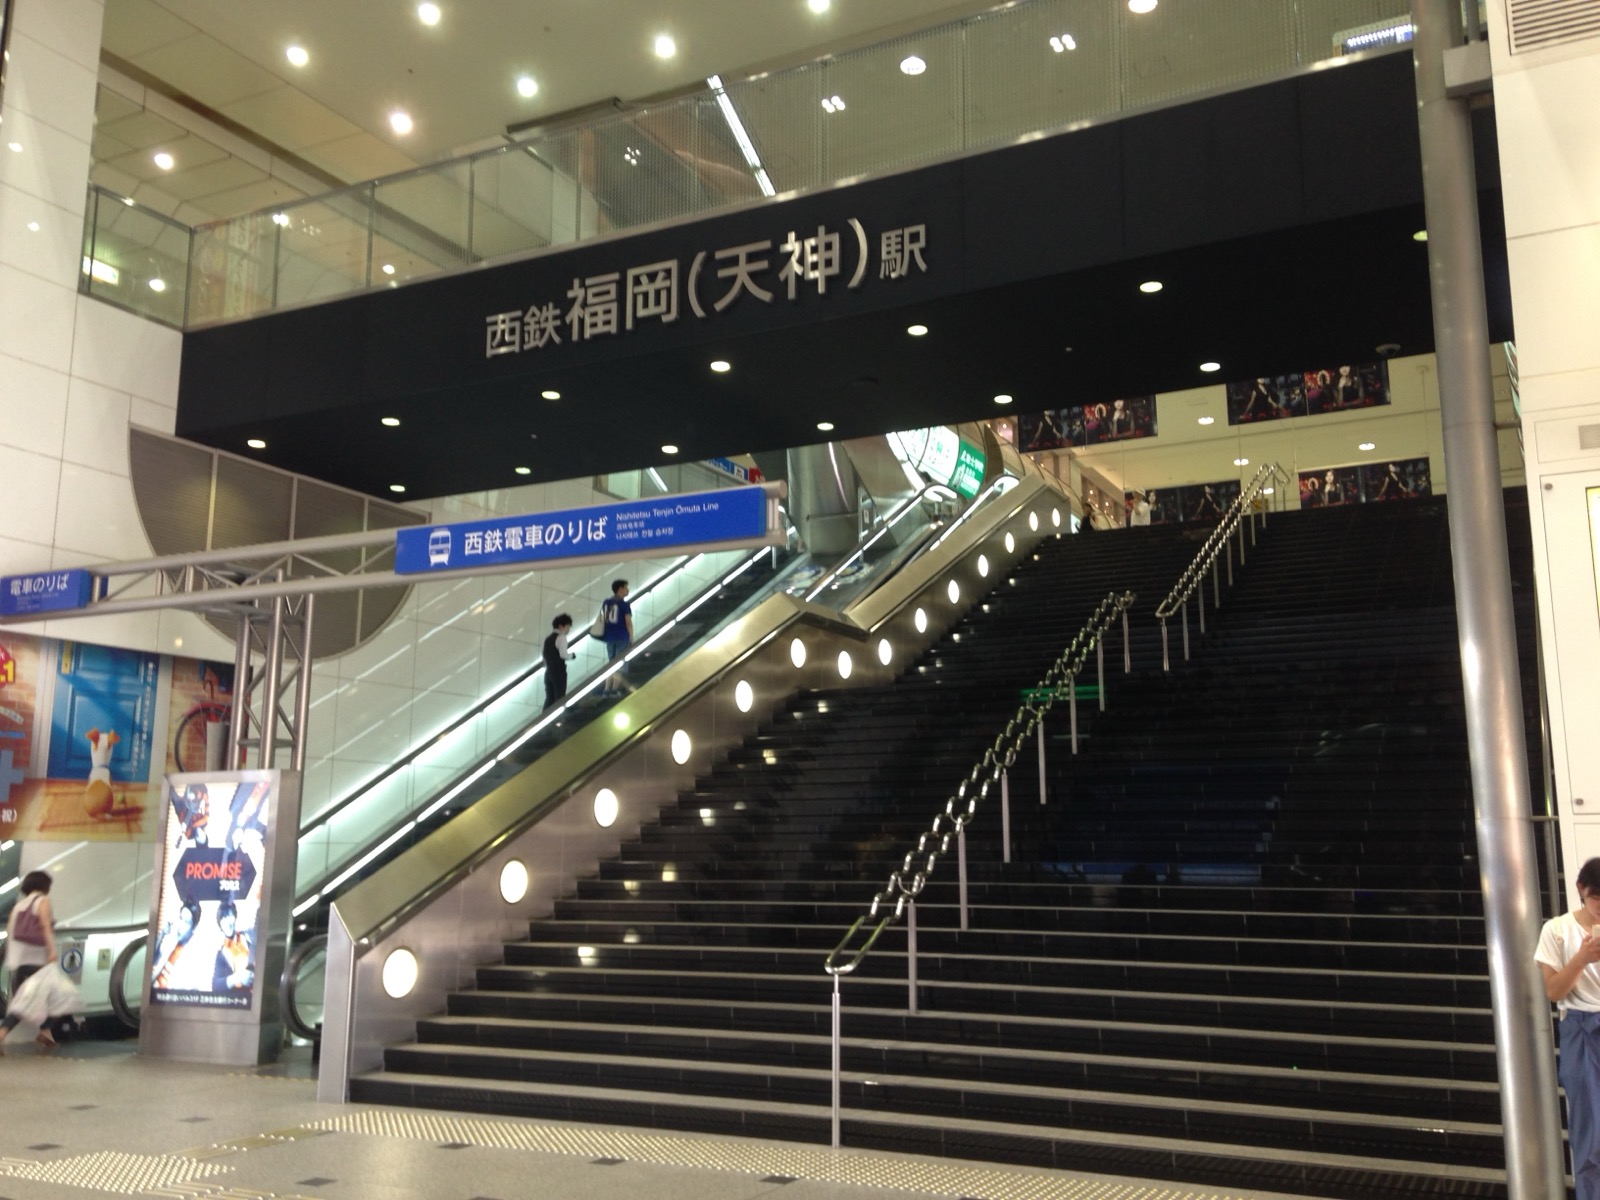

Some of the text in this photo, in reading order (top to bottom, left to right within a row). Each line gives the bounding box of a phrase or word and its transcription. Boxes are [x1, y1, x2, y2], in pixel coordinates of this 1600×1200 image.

[485, 216, 928, 358] 西鉄福岡(天神)駅
[616, 510, 651, 521] Nishitetsu
[653, 508, 674, 518] Tenjin
[703, 502, 719, 512] Line
[464, 515, 609, 556] 西鉄電車のりば
[10, 572, 70, 596] 電車のりば
[185, 862, 242, 880] PROMISE
